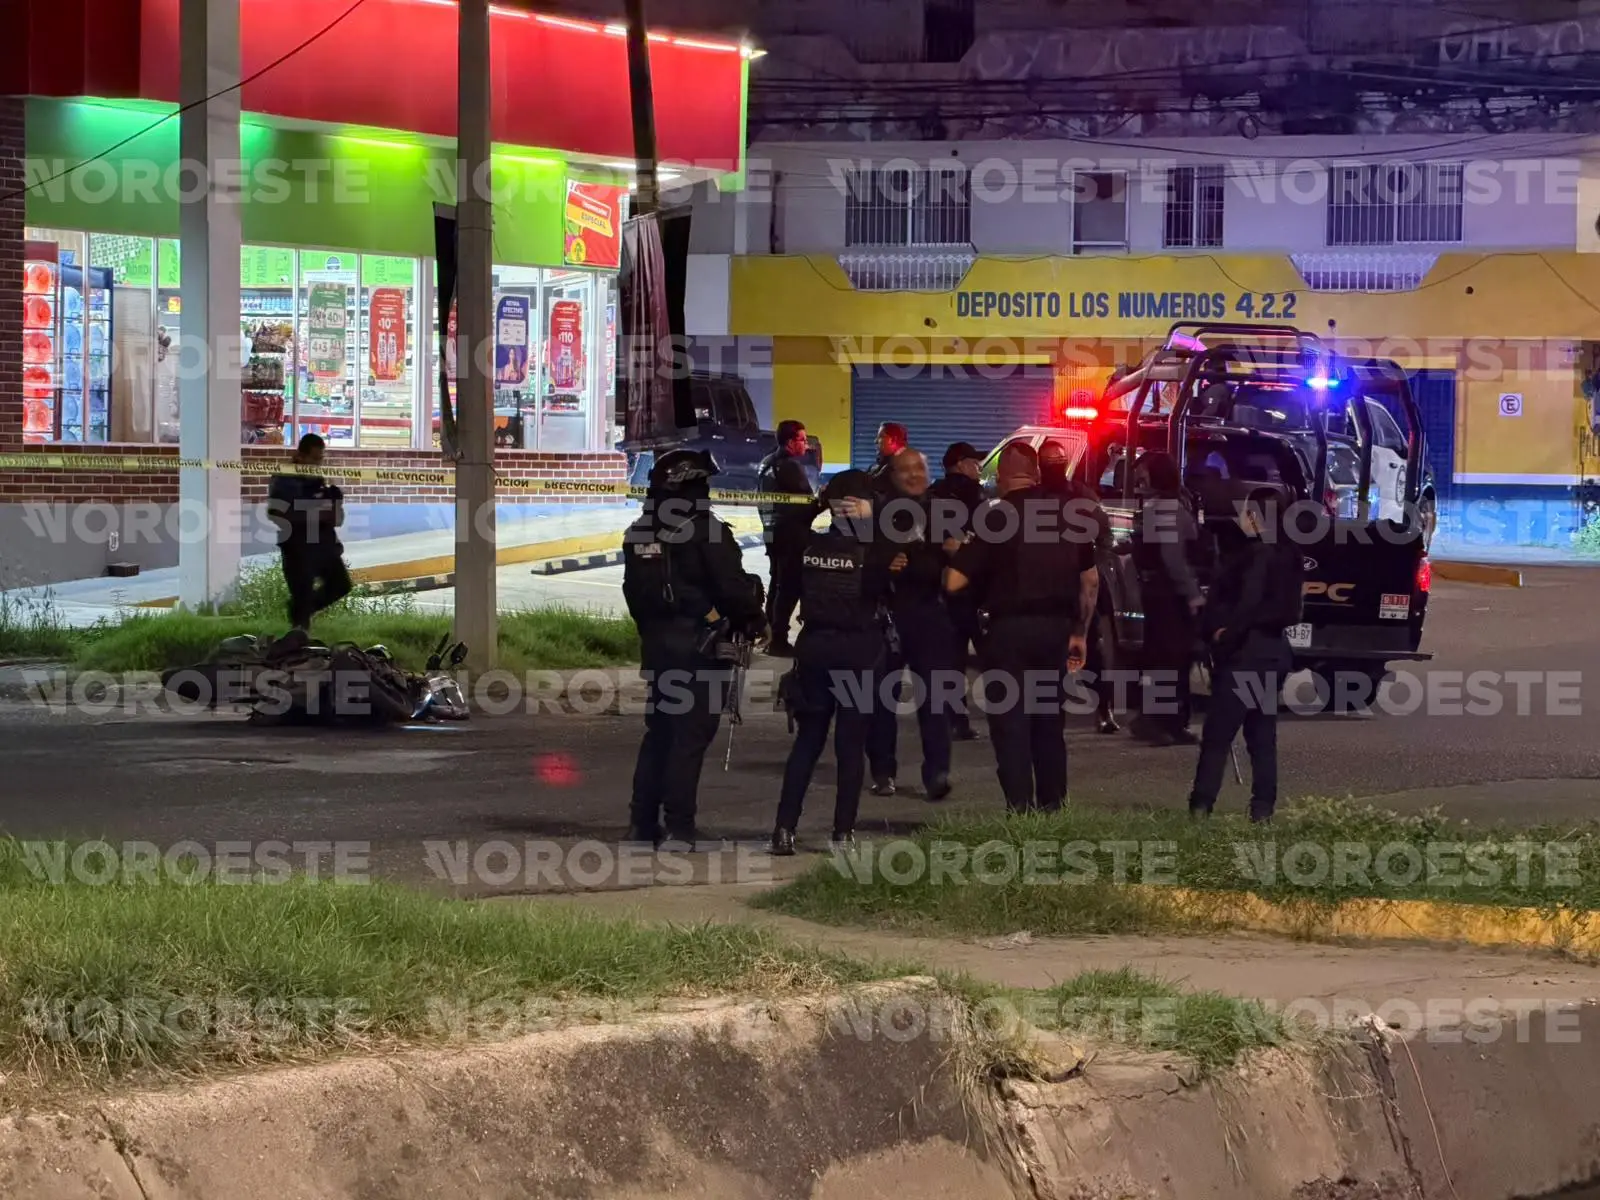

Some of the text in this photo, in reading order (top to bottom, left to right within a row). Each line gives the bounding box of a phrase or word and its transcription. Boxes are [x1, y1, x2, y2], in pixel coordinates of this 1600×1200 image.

[957, 291, 1297, 318] DEPOSITO LOS NUMEROS 4.2.2
[803, 555, 854, 569] POLICIA
